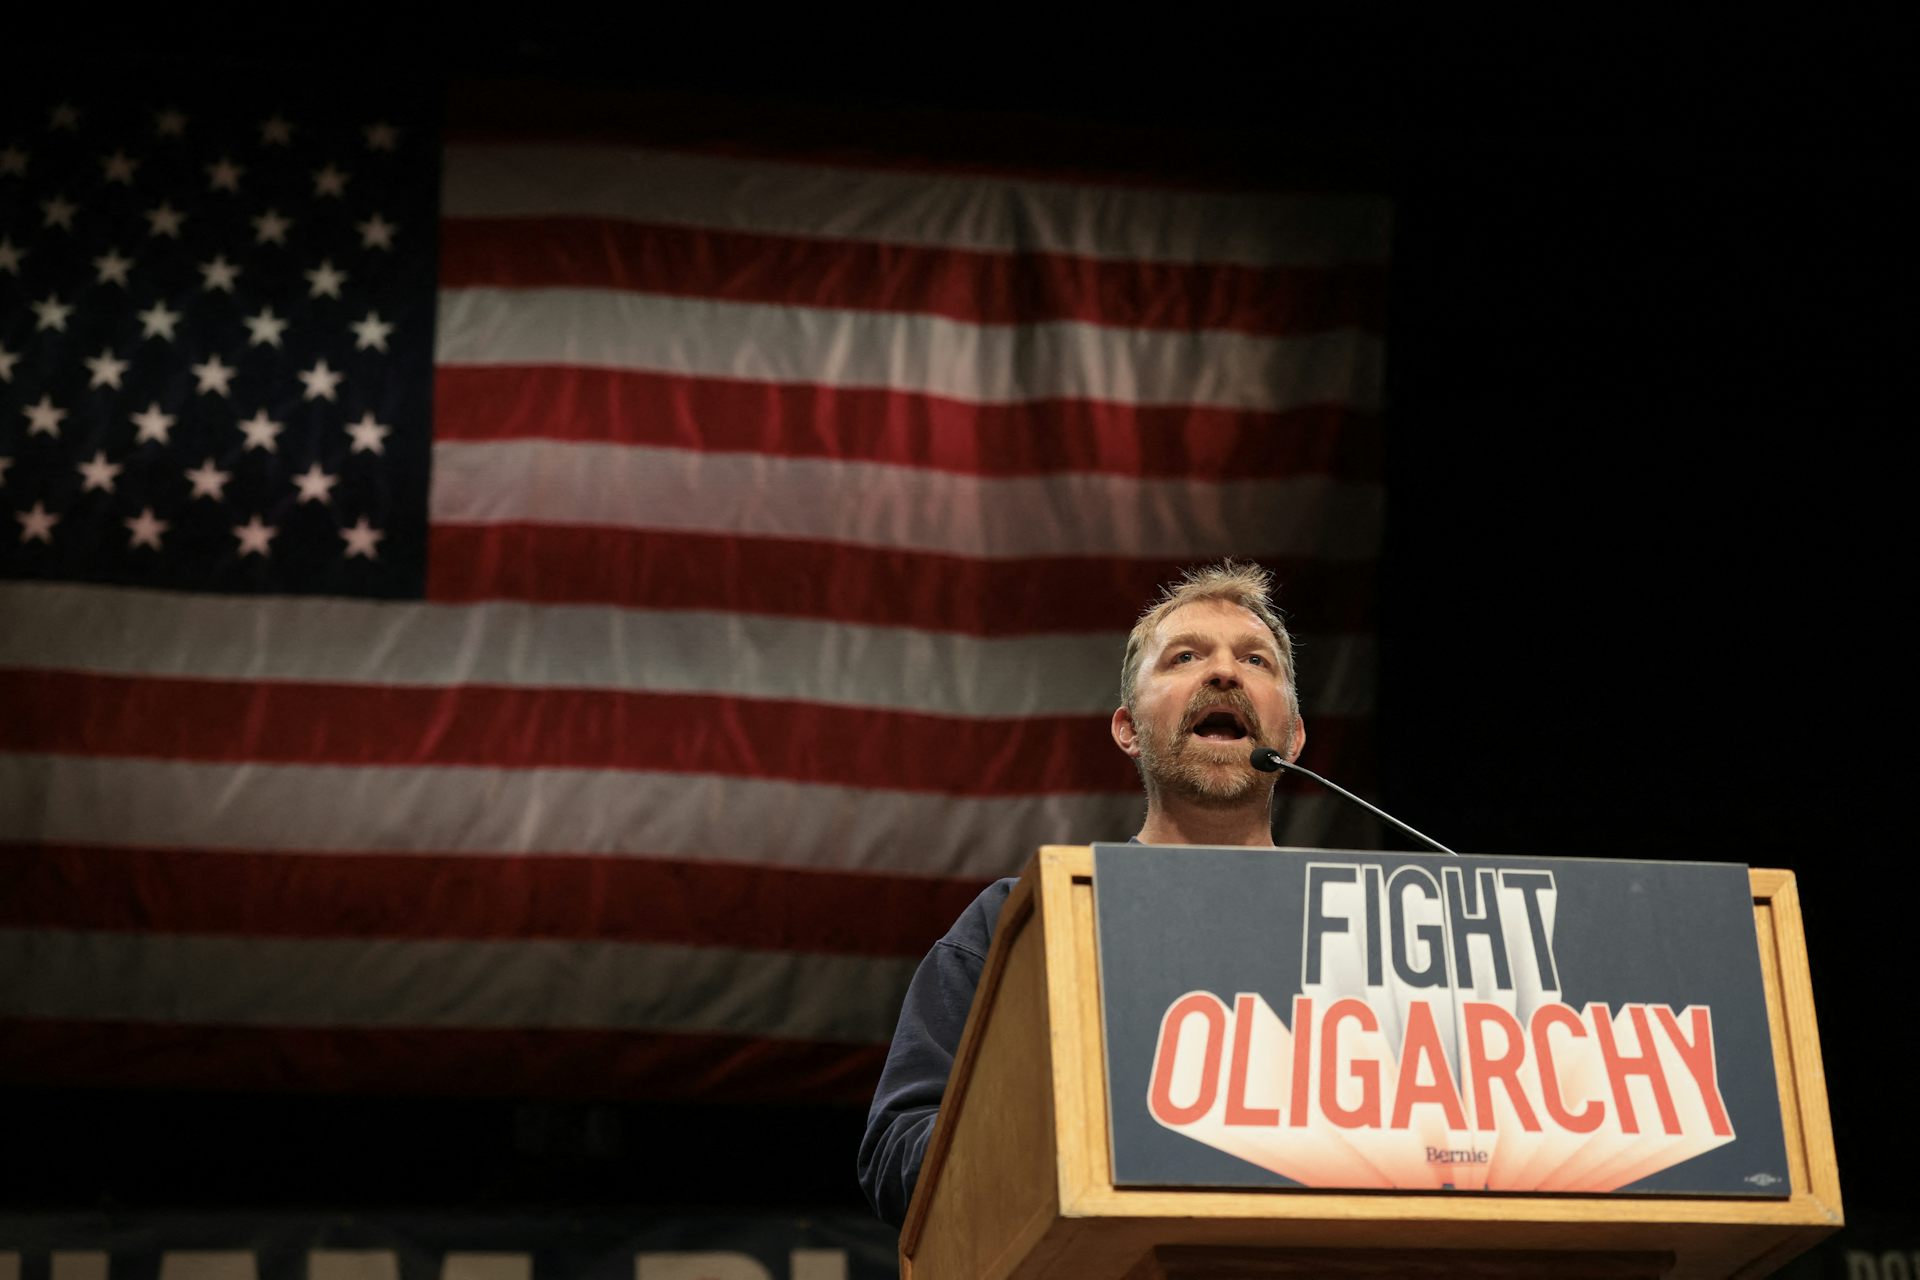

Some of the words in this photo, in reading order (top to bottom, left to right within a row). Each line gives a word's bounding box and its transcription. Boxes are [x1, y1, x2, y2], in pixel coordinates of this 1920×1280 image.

[1304, 863, 1559, 991] FIGHT
[1149, 993, 1735, 1138] OLIGARCHY
[1425, 1146, 1489, 1164] Bernie
